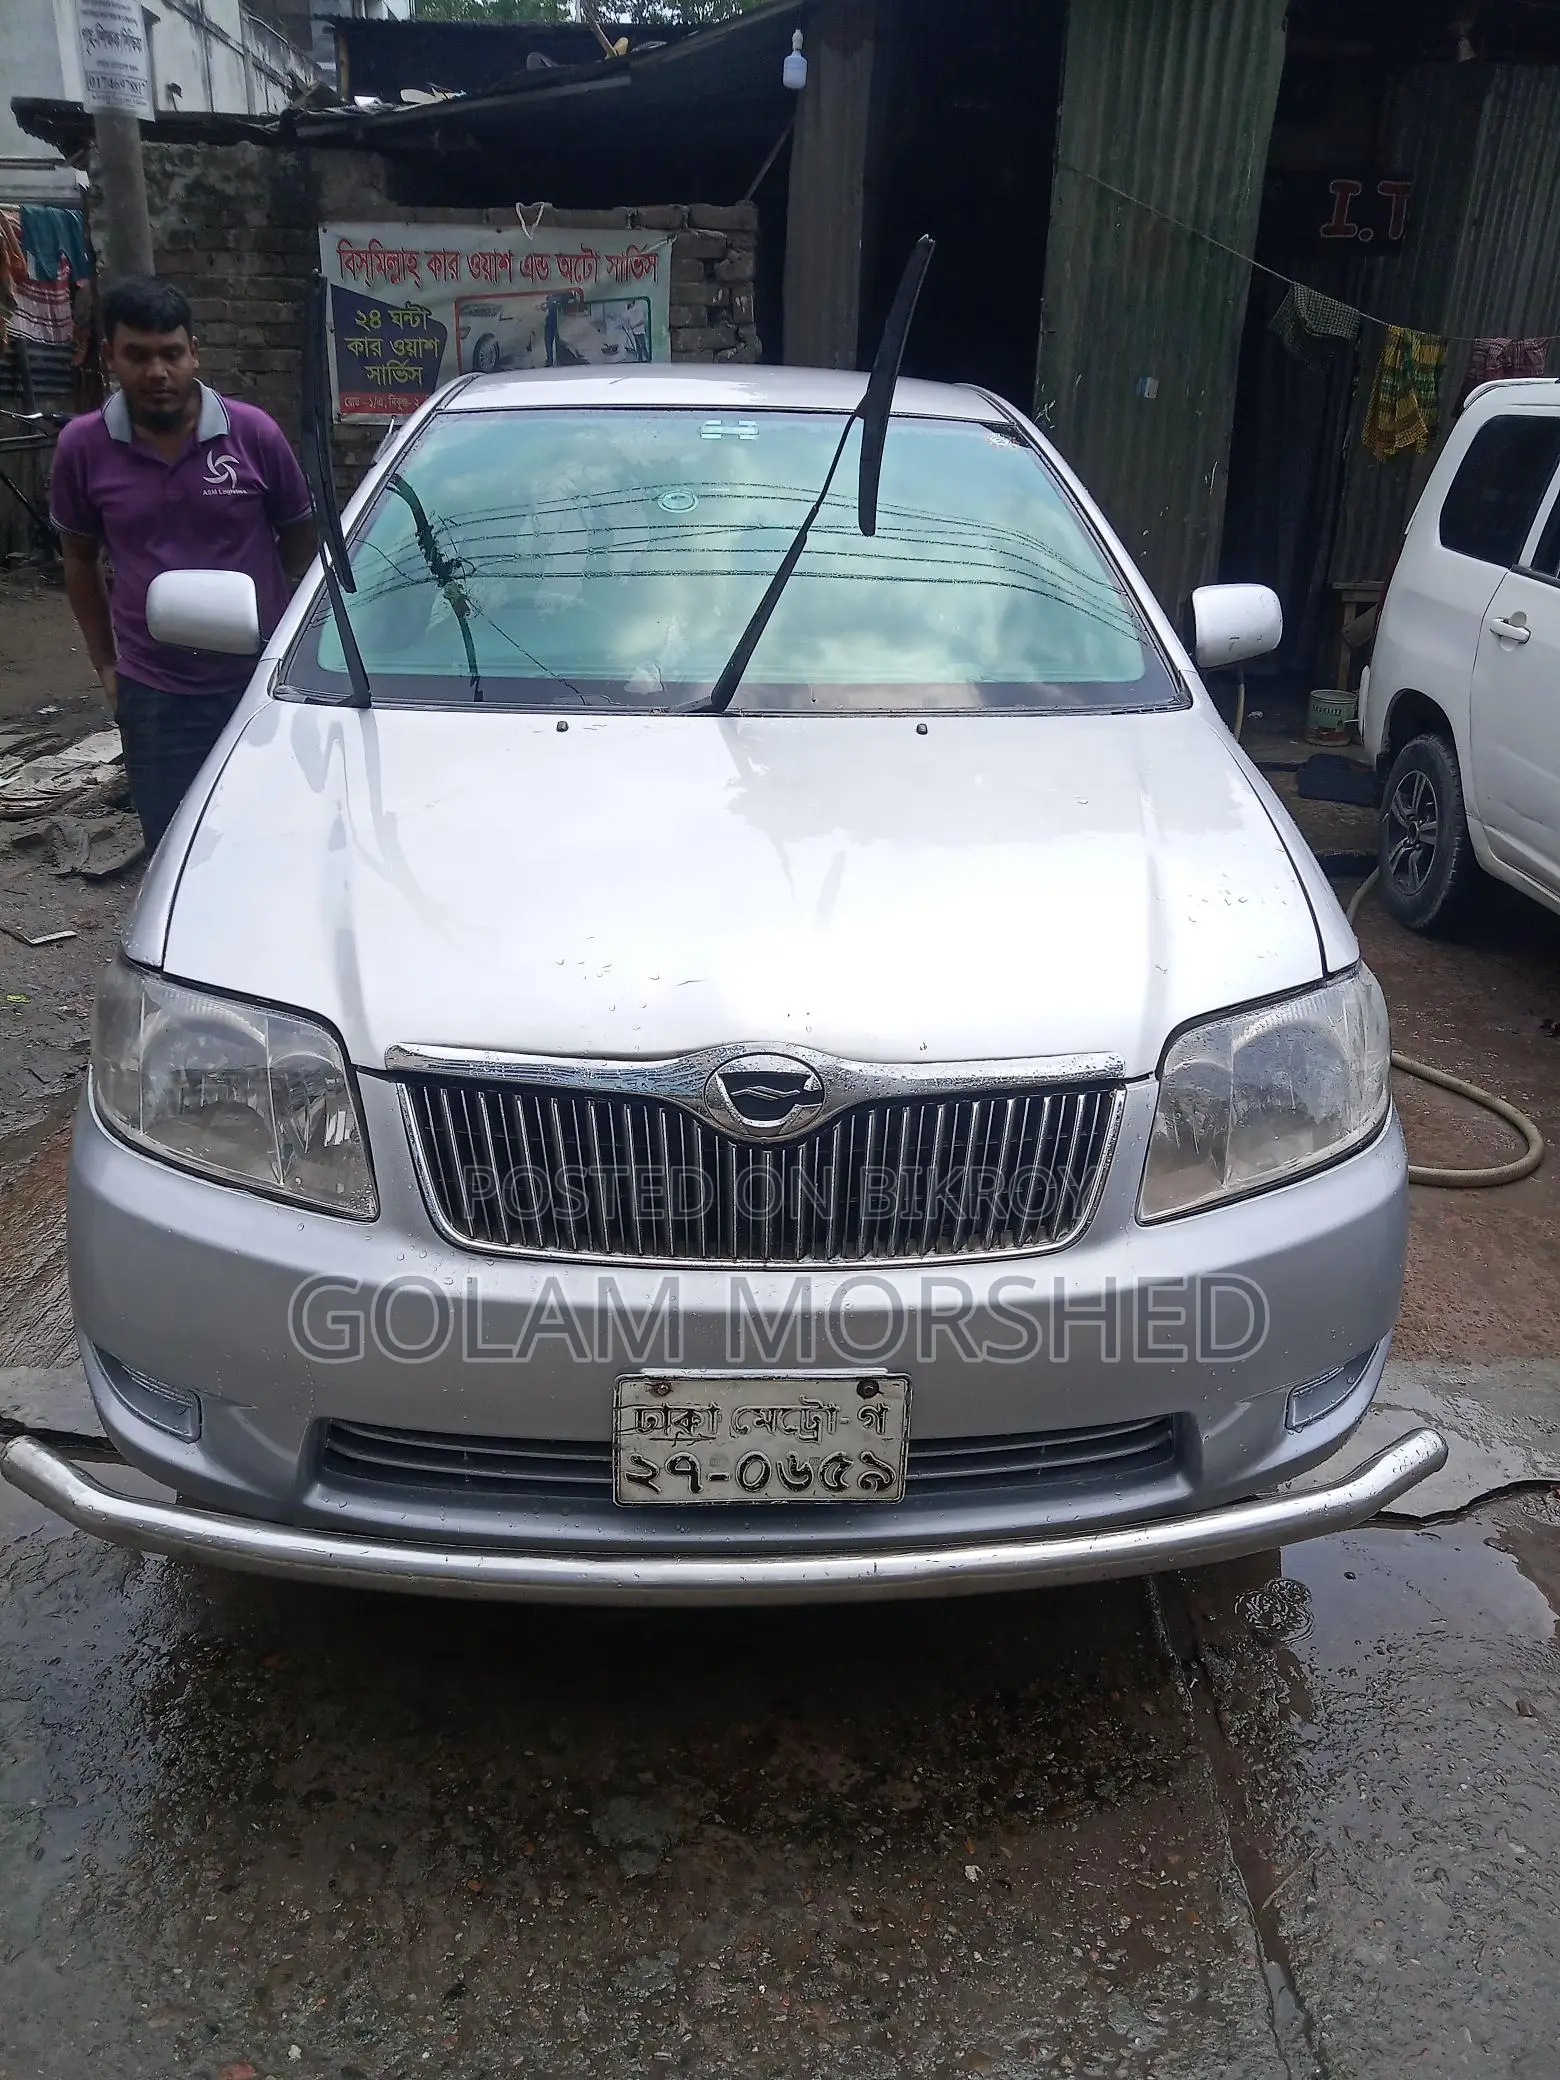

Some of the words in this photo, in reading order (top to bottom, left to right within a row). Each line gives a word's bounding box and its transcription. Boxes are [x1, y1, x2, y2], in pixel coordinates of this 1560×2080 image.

[424, 248, 461, 282] কার
[555, 243, 601, 284] অটো
[604, 243, 658, 284] সার্ভিস
[355, 309, 382, 332] ২৪
[344, 336, 384, 358] কার
[364, 359, 424, 386] সার্ভিস
[625, 1451, 897, 1494] ২৭-০৬৫৯
